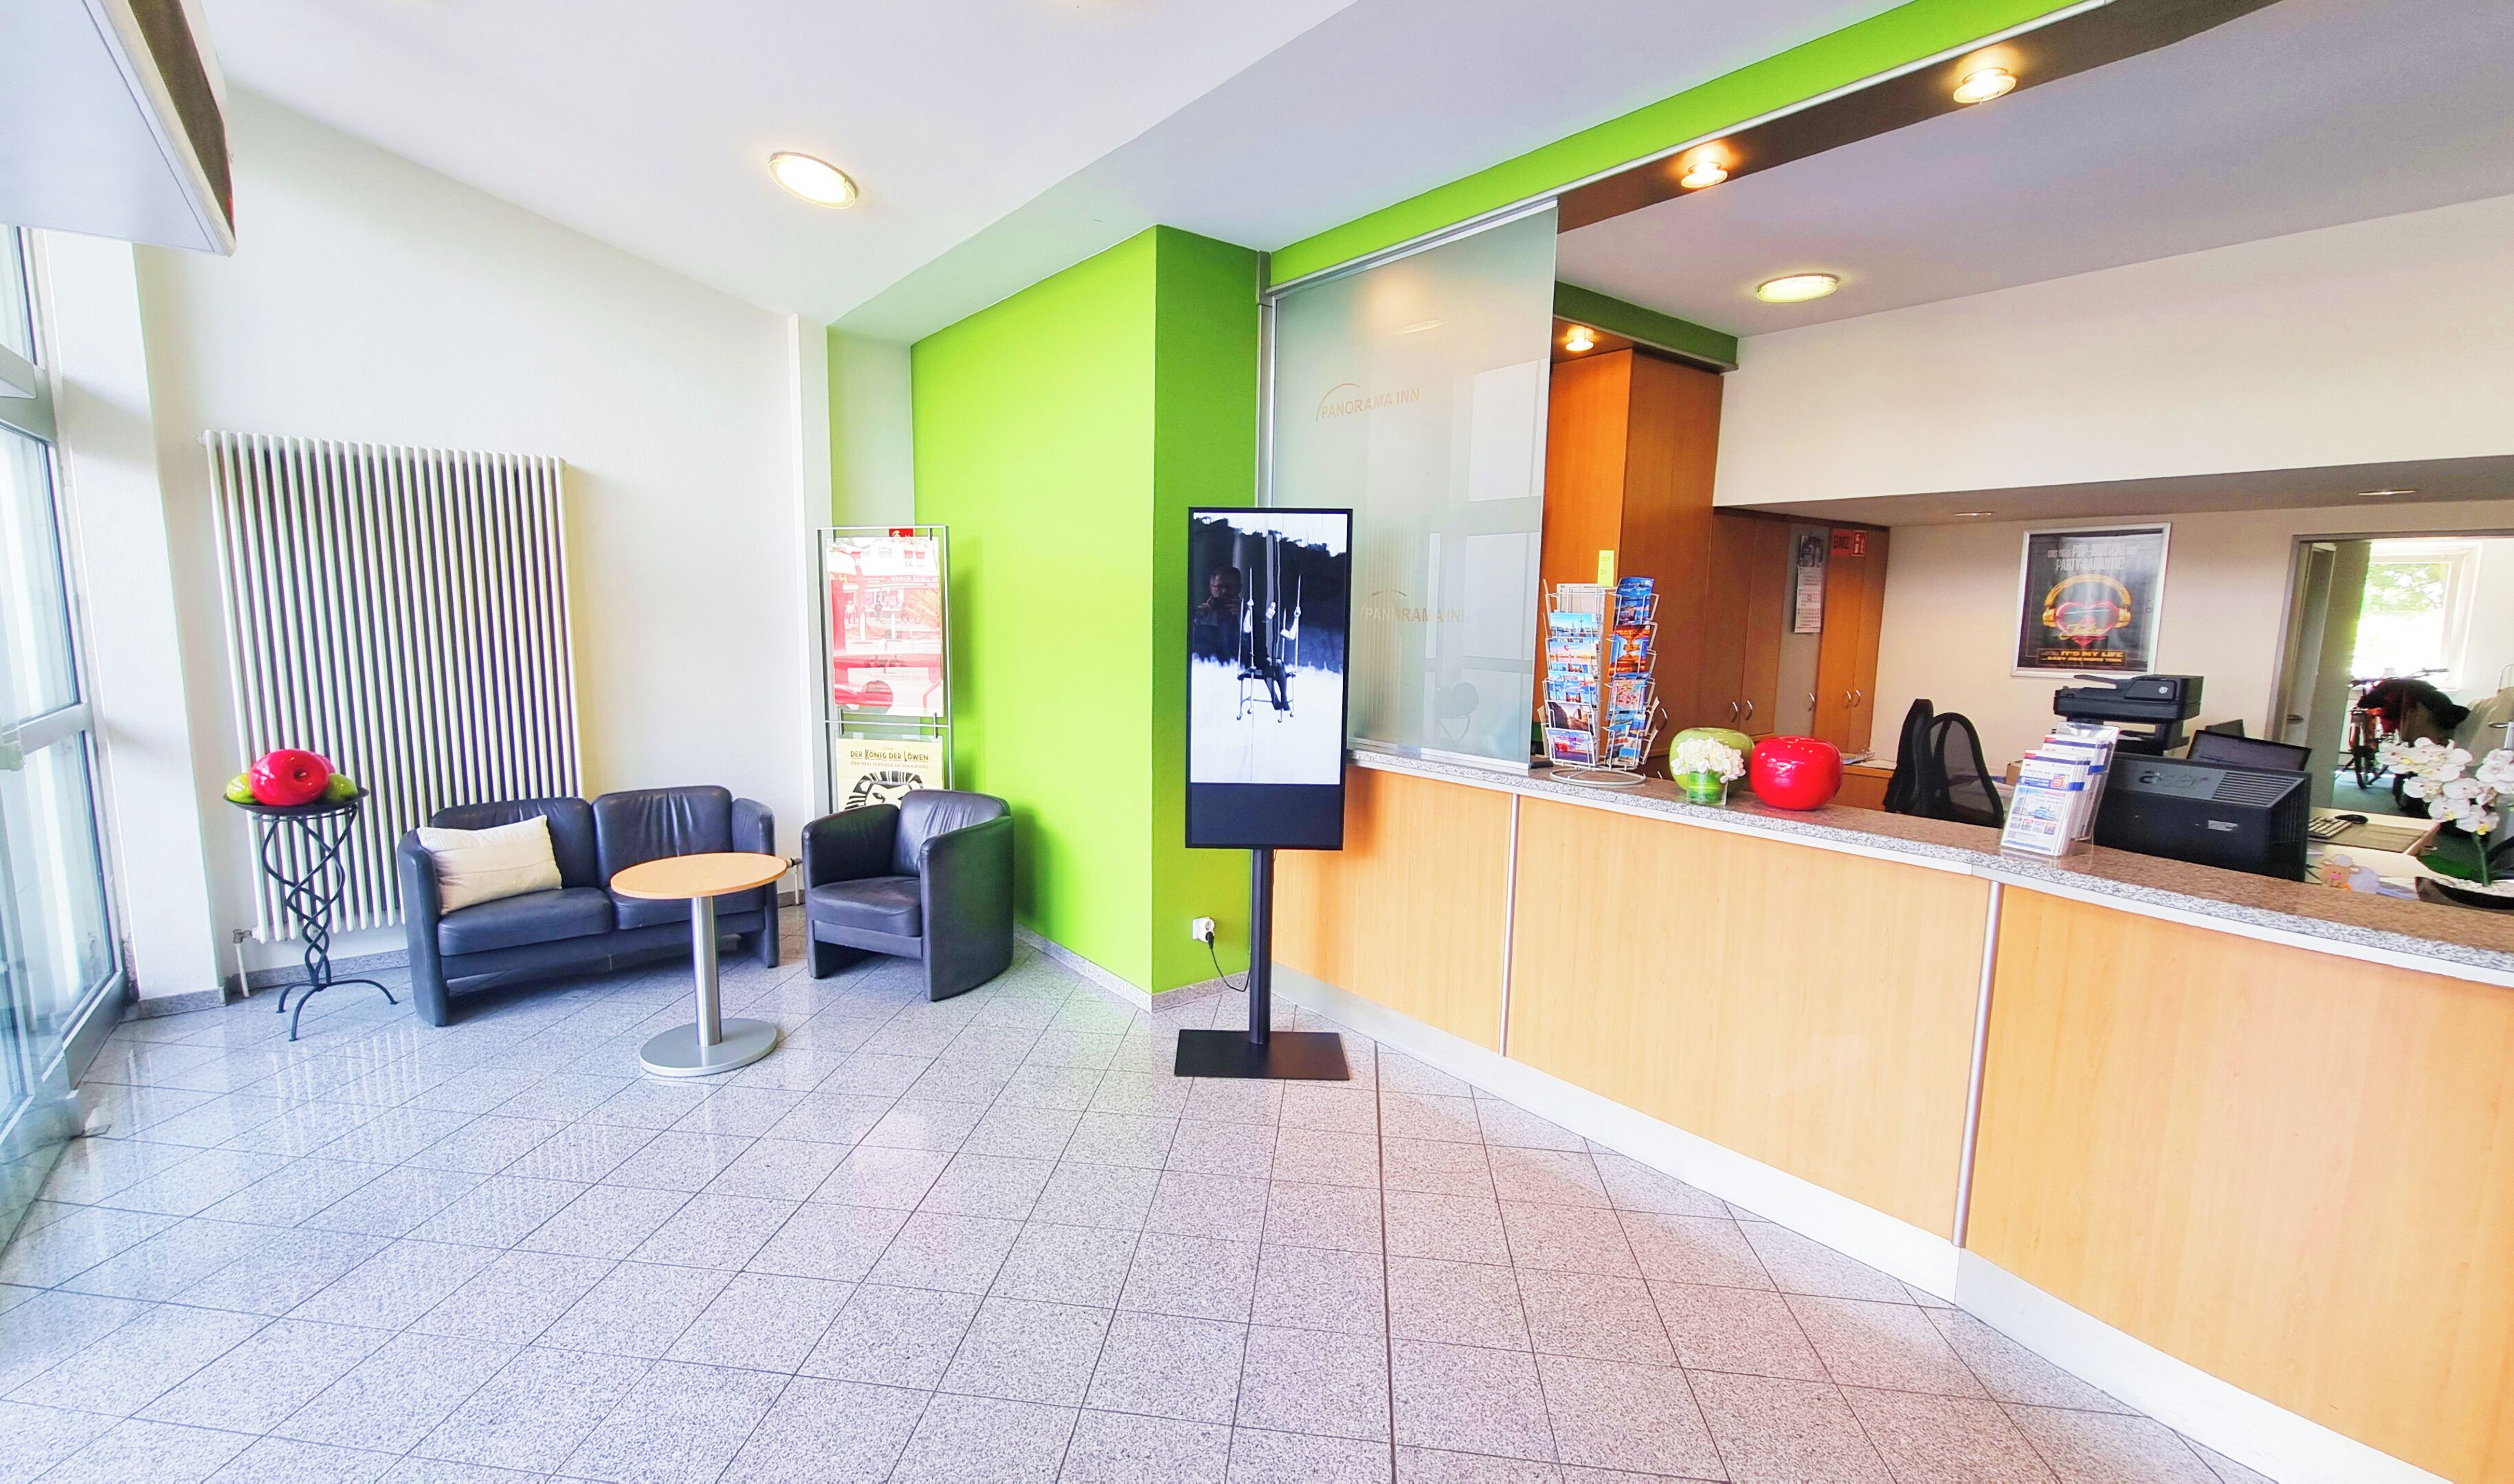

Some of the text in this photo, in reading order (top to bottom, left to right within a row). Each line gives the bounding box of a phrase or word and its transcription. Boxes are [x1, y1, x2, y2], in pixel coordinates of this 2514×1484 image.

[1321, 387, 1420, 419] PANORAMA INN
[865, 749, 887, 760] KÖNIG
[904, 751, 929, 762] LÖWEN
